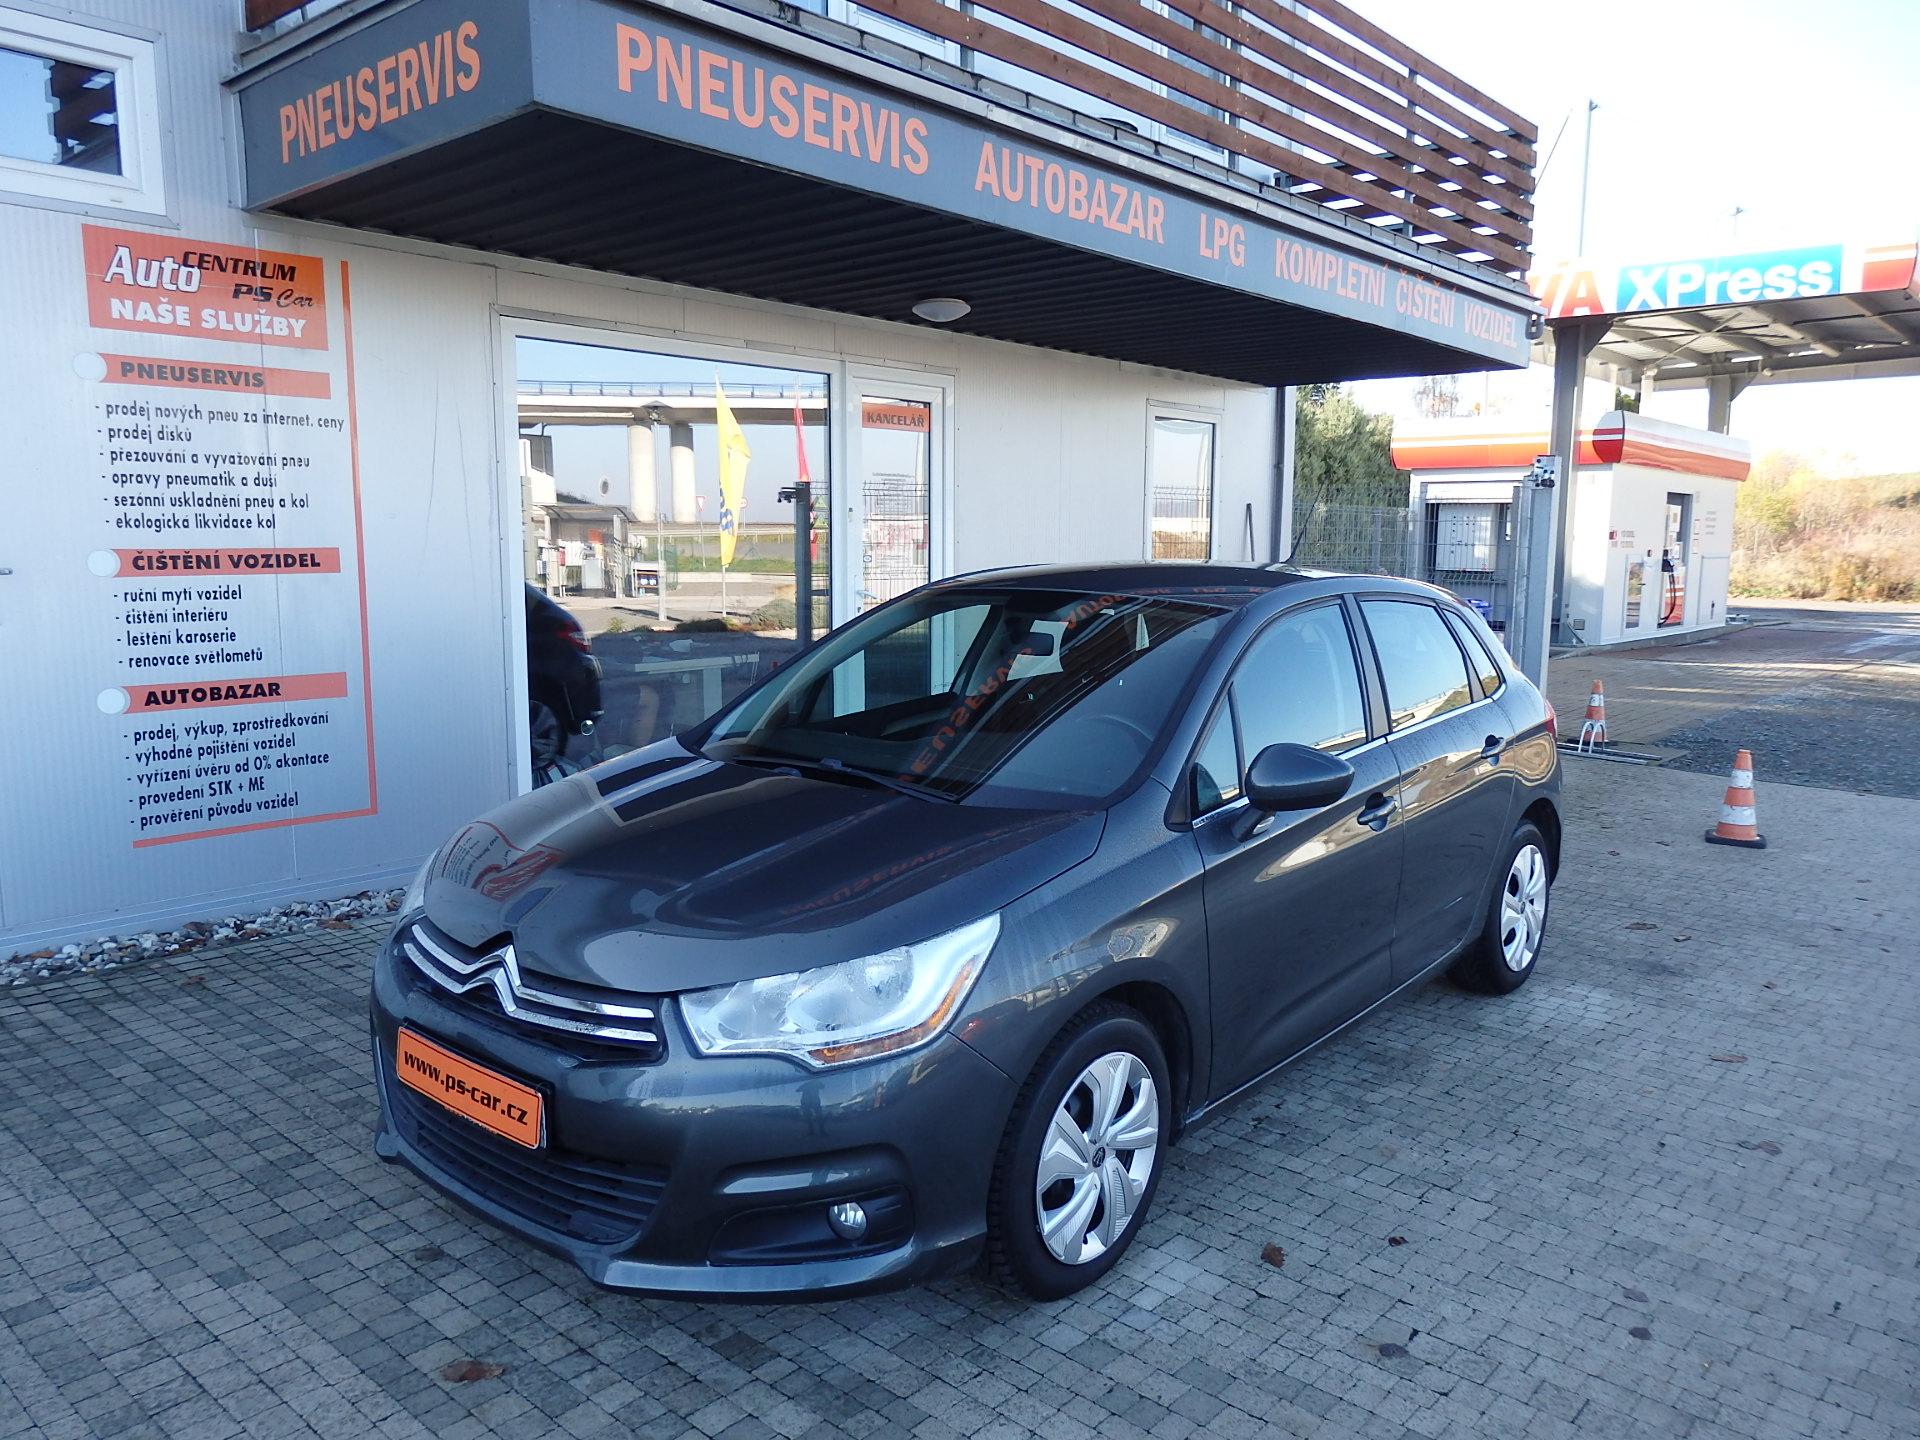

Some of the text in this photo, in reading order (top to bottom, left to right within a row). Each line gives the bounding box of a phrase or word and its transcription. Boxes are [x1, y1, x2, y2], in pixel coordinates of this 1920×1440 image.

[280, 21, 481, 165] PNEUSERVIS
[615, 23, 1518, 348] PNEUSERVIS AUTOBAZAR LPG KOMPLETNÍ ČIŠTĚNÍ VOZIDEL
[103, 244, 297, 294] Auto CENTRUM
[232, 283, 314, 309] PS Car
[1621, 260, 1834, 313] XPress
[110, 296, 307, 338] NAŠE SLUŽBY
[120, 361, 265, 388] PNEUSERVIS
[106, 400, 345, 432] prodej nových pneu za internet. ceny
[866, 412, 925, 428] KANCELÁŘ
[108, 423, 152, 445] prodej
[110, 447, 310, 470] přezouvání a vyvažování pneu
[112, 473, 161, 489] opravy
[166, 470, 236, 489] pneumatik
[241, 476, 248, 487] a
[114, 491, 309, 512] sezónní uskladnění pneu a kol
[116, 512, 276, 533] ekologická likvidace kol
[132, 549, 321, 571] ČIŠTĚNÍ VOZIDEL
[123, 584, 242, 606] ruční mytí vozidel
[125, 606, 228, 625] čištění interiéru
[126, 626, 237, 647] leštění karoserie
[128, 646, 264, 668] renovace světlometů
[144, 682, 282, 707] AUTOBAZAR
[133, 710, 329, 746] prodej, výkup, zprostředkování
[135, 732, 296, 767] výhodné pojištění vozidel
[136, 752, 330, 788] vyřízení úvěru od 0% akontace
[138, 785, 205, 810] provedení
[208, 779, 233, 797] STK
[248, 776, 265, 792] ME
[140, 791, 299, 831] prověření původu vozidel
[403, 1049, 528, 1127] www.ps-car.cz
